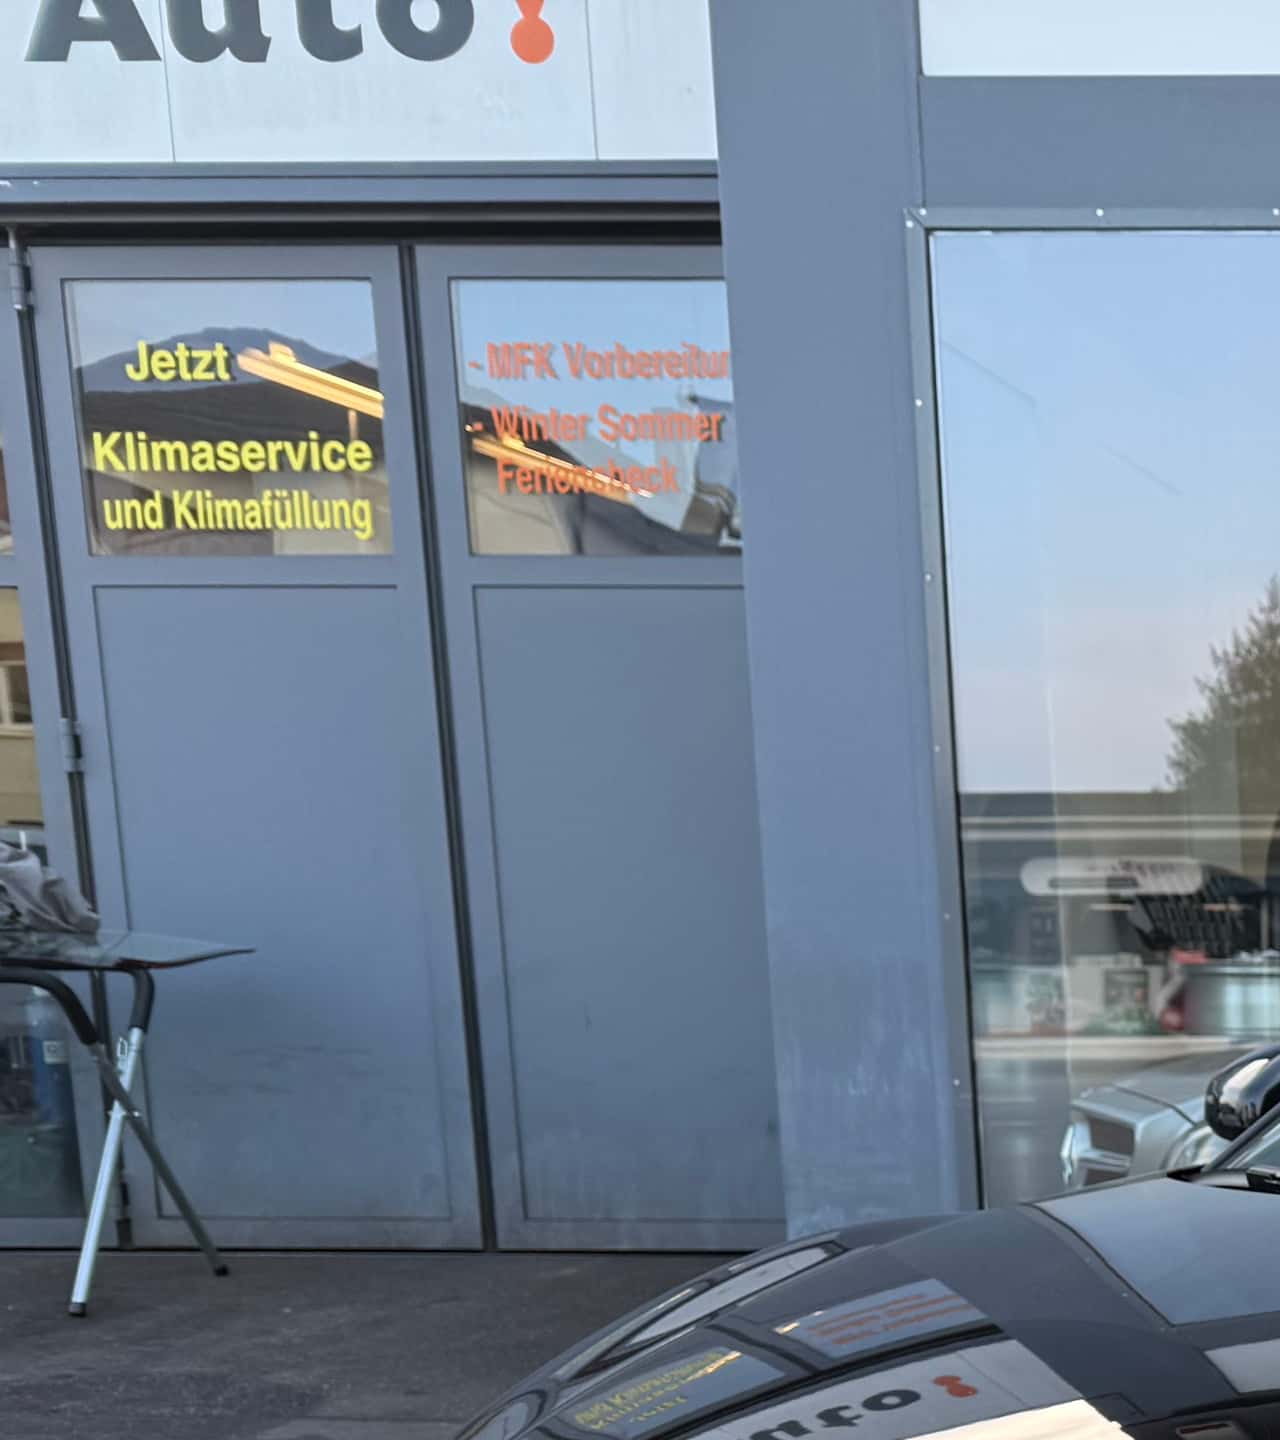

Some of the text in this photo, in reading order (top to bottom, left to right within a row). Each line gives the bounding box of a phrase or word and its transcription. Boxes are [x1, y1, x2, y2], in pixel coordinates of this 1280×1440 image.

[125, 341, 231, 382] Jetzt
[487, 342, 558, 379] MFK
[491, 404, 724, 442] Winter Sommer
[92, 432, 373, 473] Klimaservice
[103, 490, 373, 541] und Klimafüllung
